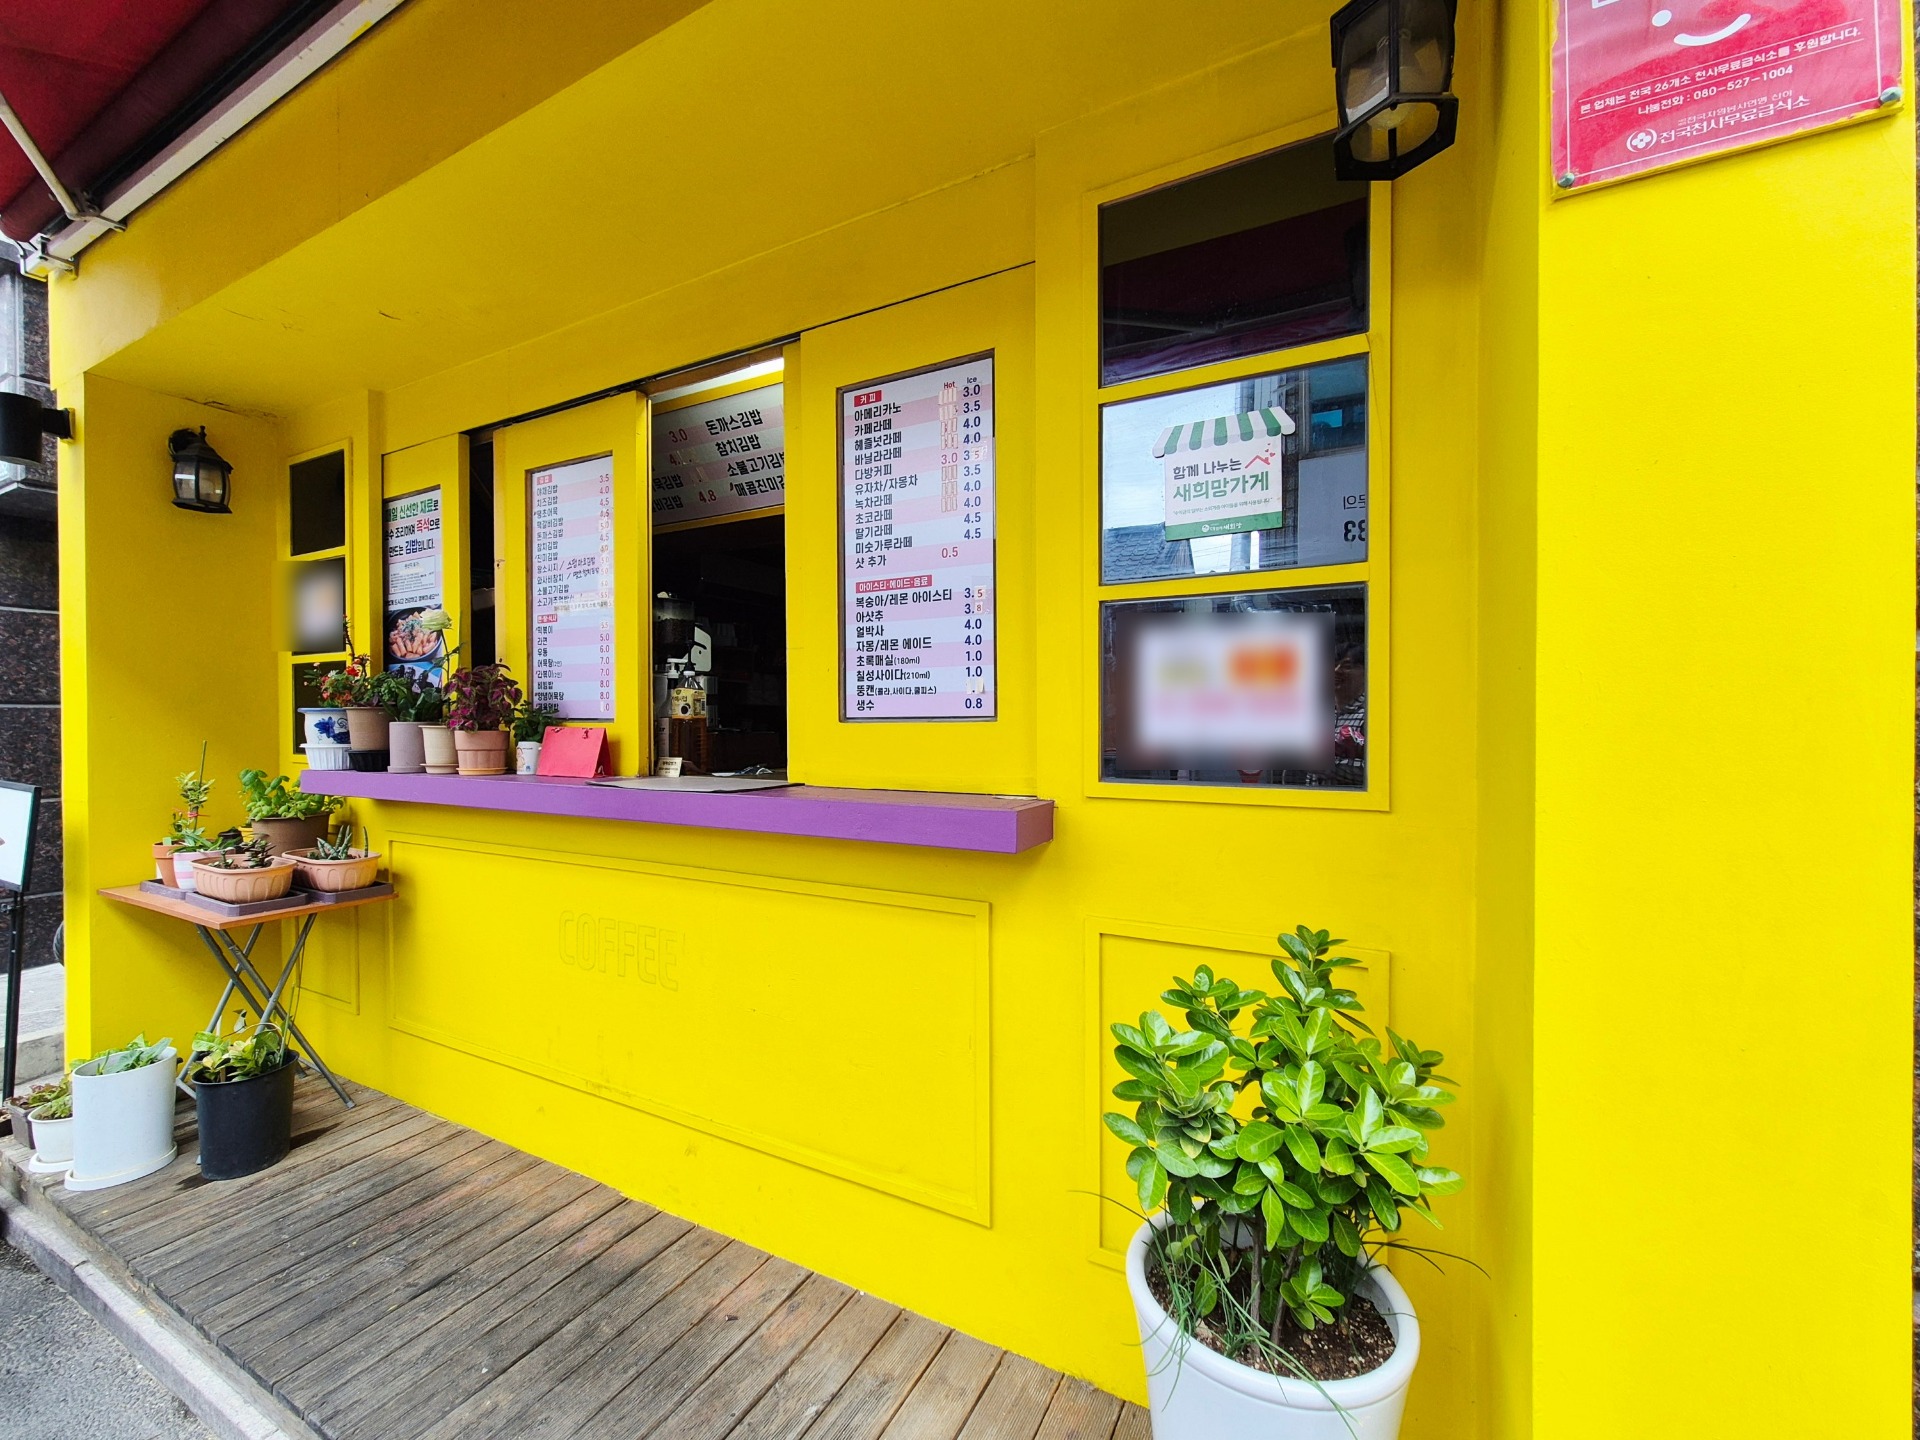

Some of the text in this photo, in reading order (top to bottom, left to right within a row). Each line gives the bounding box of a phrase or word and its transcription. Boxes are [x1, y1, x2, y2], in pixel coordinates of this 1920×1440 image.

[1580, 27, 1861, 114] 본 업체는 전국 26개소 천사무료급식소를 후원합니다.
[1638, 94, 1684, 114] 나눔전화
[1694, 65, 1793, 100] 080-527-1004
[1660, 95, 1810, 143] 전국천사무료급식소
[944, 381, 955, 389] Hot
[855, 384, 980, 421] 아메리카노 3.0
[705, 409, 763, 435] 돈까스김밥
[855, 400, 980, 436] 카페라떼 3.5
[669, 428, 687, 443] 3.0
[855, 416, 980, 451] 헤즐넛라떼 4.0
[715, 434, 761, 457] 참치김밥
[855, 432, 980, 466] 바닐라라떼 4.0
[855, 464, 892, 480] 다방커피
[941, 453, 958, 464] 3.0
[1173, 458, 1242, 480] 함께 나누는
[537, 474, 609, 496] 야채김밥 3.5
[855, 464, 980, 495] 유자차/자몽차 3.5
[1173, 471, 1269, 502] 새희망가게
[537, 486, 609, 507] 치즈김밥 4.0
[600, 498, 609, 506] 4.5
[699, 489, 717, 503] 4.8
[855, 480, 981, 509] 녹차라떼 4.0
[400, 502, 418, 519] 신선한
[420, 498, 438, 513] 재료로
[855, 496, 981, 524] 초코라떼 4.0
[395, 524, 415, 538] 조리하여
[417, 517, 440, 533] 즉석으로
[537, 529, 563, 541] 돈까스김밥
[856, 512, 981, 540] 딸기라떼 4.5
[389, 538, 435, 557] 만드는 김밥입니다.
[537, 541, 558, 552] 참치김밥
[856, 528, 981, 554] 미숫가루라떼 4.5
[856, 546, 958, 569] 샷 추가 0.5
[537, 563, 558, 574] 왕소시지
[537, 574, 563, 585] 와사비참치
[537, 584, 569, 595] 소불고기김밥
[856, 588, 983, 608] 복숭아/레몬 아이스티 3.5
[856, 602, 982, 623] 아샷추 3.8
[537, 625, 553, 635] 떡볶이
[856, 619, 982, 638] 얼박사 4.0
[538, 633, 609, 646] 라면 5.0
[856, 635, 982, 652] 자몽/레몬 에이드 4.0
[538, 645, 609, 657] 우동 6.0
[600, 656, 609, 665] 7.0
[966, 651, 982, 661] 1.0
[966, 666, 982, 677] 1.0
[538, 680, 609, 690] 비빔밥 8.0
[538, 691, 609, 701] 양념어묵탕 8.0
[856, 698, 982, 711] 생수 0.8
[559, 910, 679, 992] COFFEE
